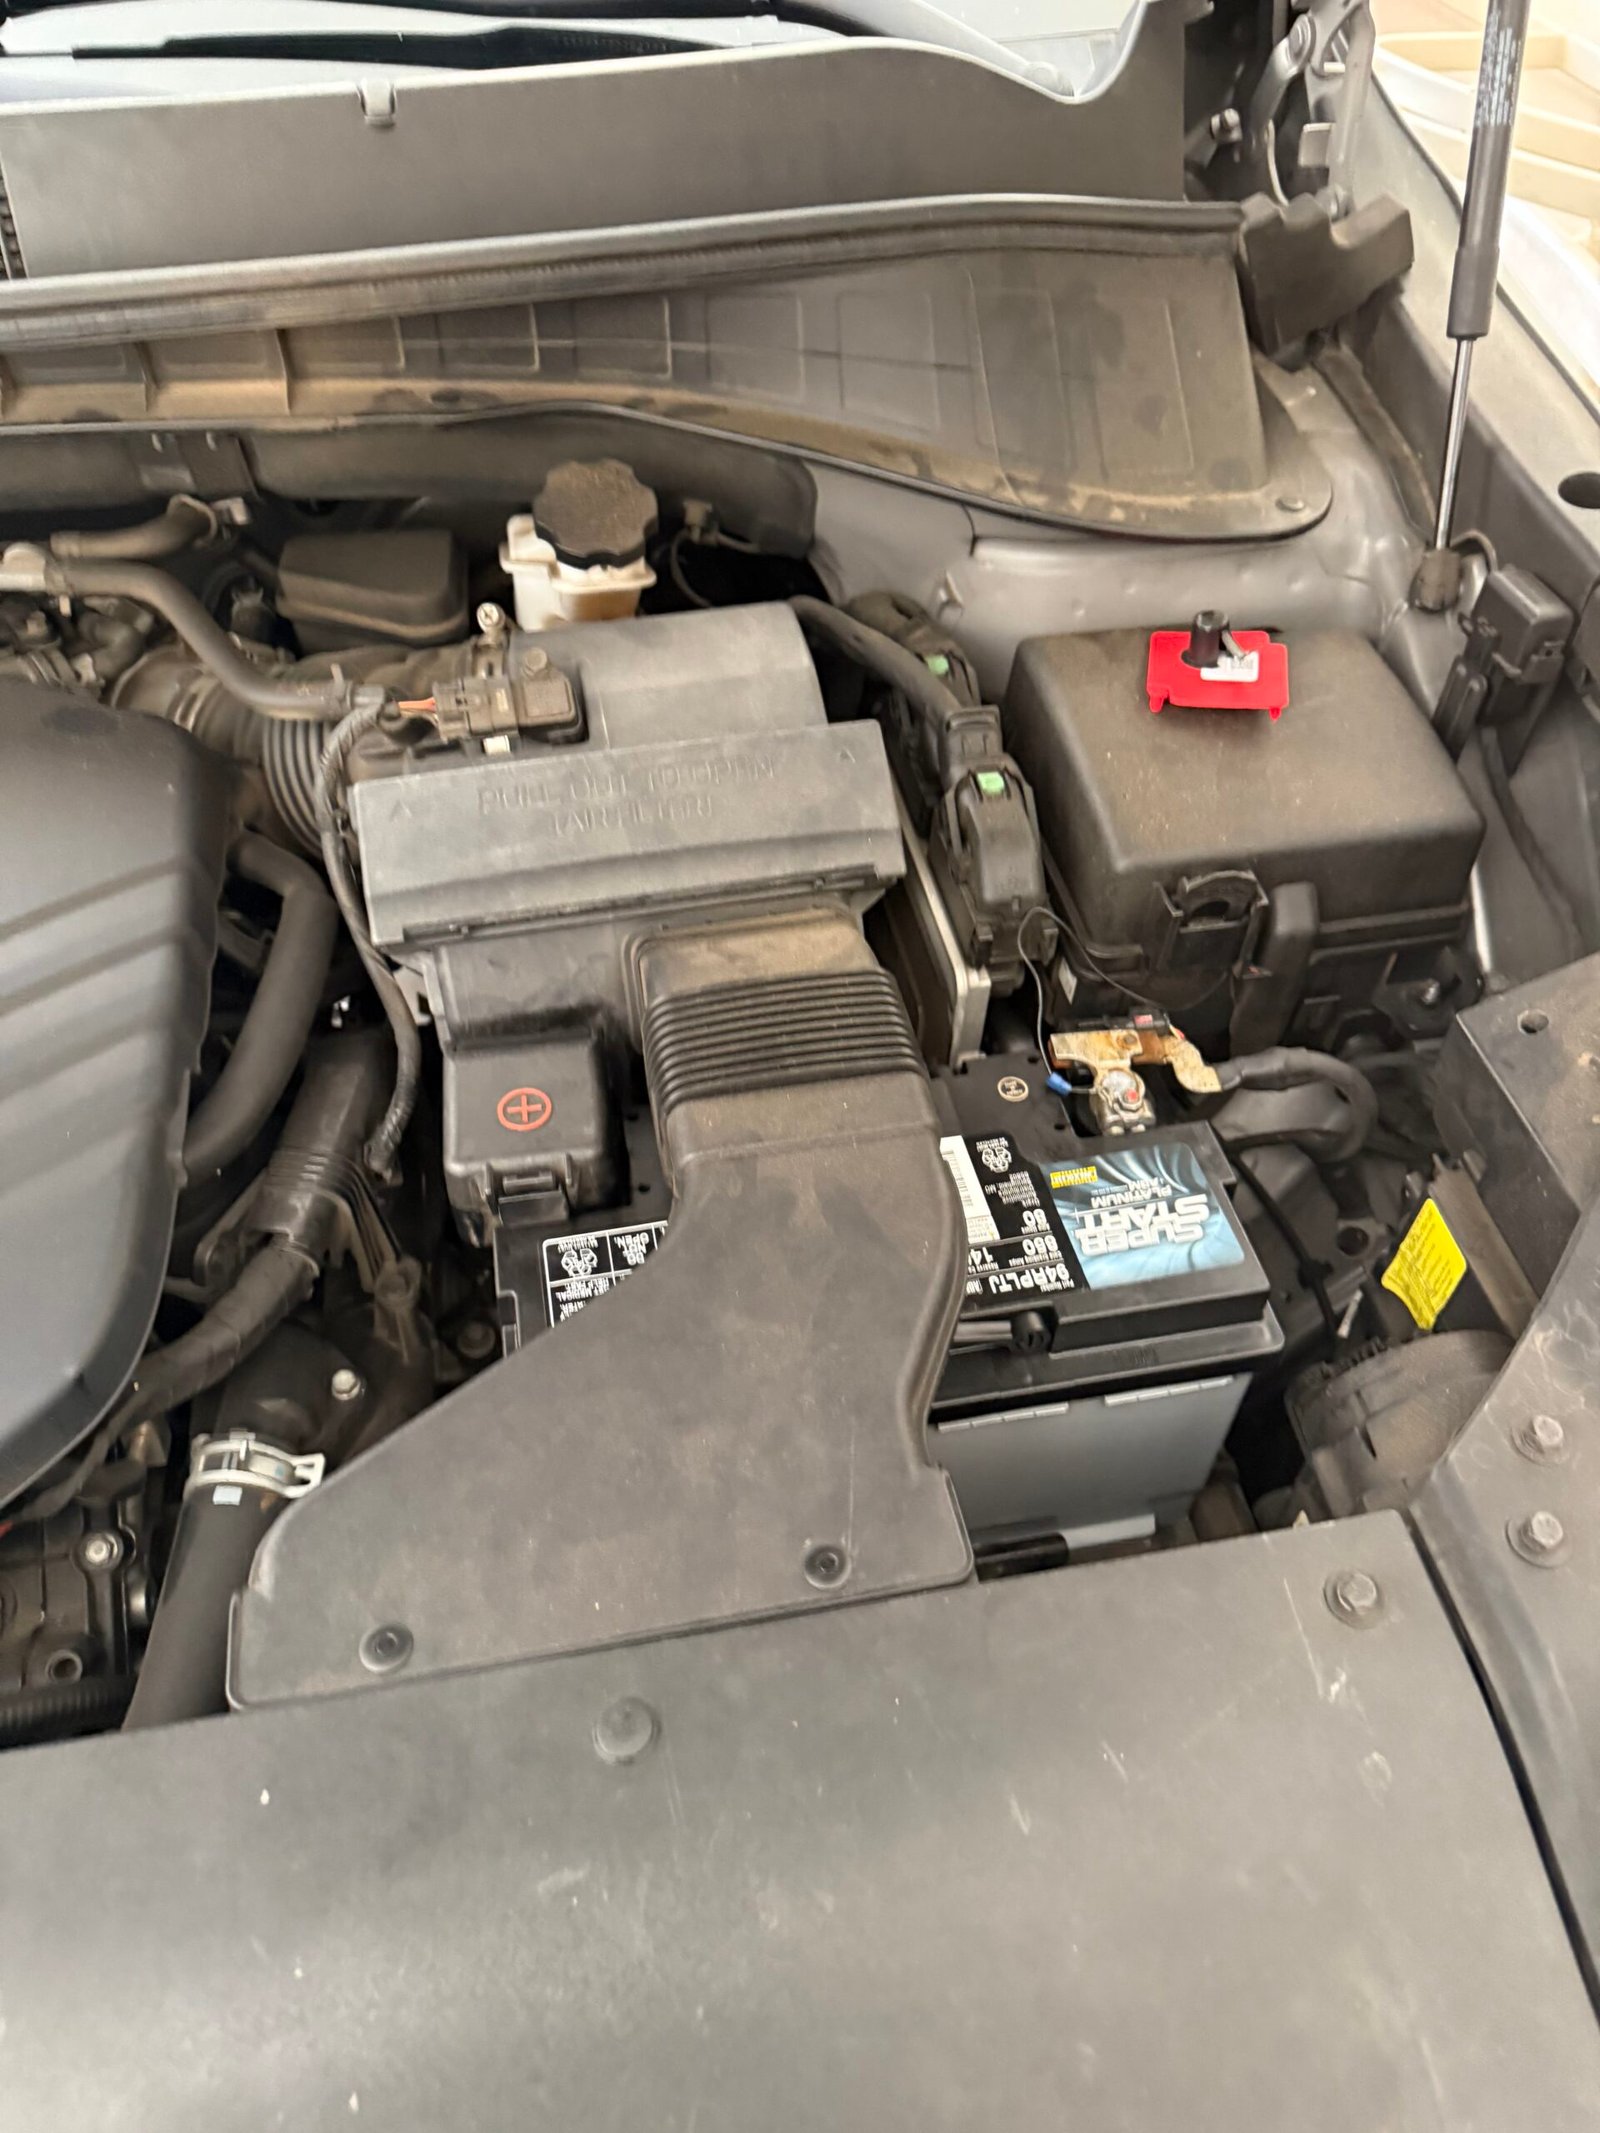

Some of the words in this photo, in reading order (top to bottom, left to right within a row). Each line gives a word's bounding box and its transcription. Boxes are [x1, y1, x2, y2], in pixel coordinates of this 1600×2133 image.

[984, 1183, 997, 1195] MO
[1090, 1184, 1173, 1208] PLATINUM
[1075, 1193, 1210, 1237] START
[1078, 1222, 1204, 1255] SUPER
[988, 1263, 1070, 1293] 94RPLTJ
